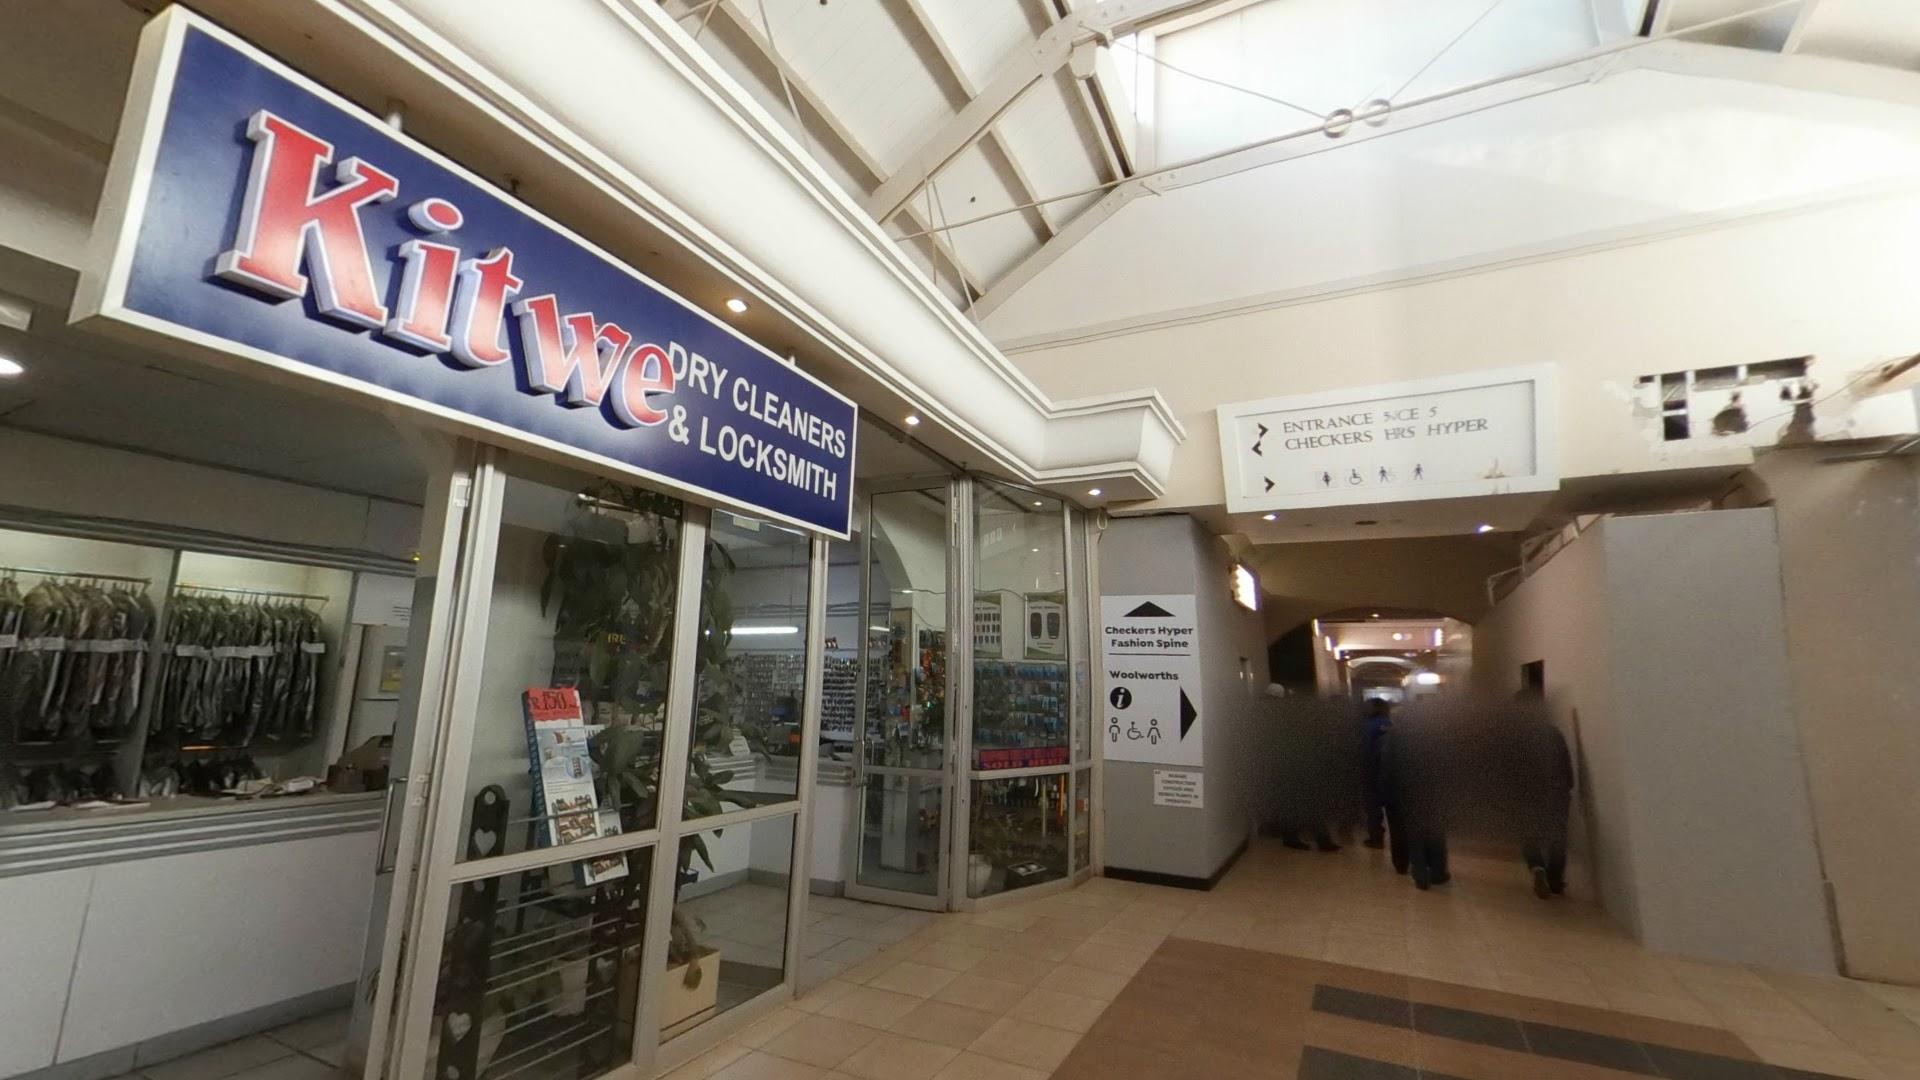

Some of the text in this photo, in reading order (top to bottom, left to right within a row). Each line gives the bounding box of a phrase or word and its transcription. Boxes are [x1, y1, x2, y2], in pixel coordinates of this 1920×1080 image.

[215, 109, 675, 427] Kitwe
[669, 341, 846, 458] DRY CLEANERS
[1283, 412, 1373, 433] ENTRANCE
[1285, 431, 1373, 450] CHECKERS
[1427, 418, 1488, 436] HYPER
[668, 405, 837, 501] & LOCKSMITH
[1105, 626, 1194, 637] Checkers Hyper
[1111, 639, 1189, 649] Fashion Spine
[1109, 670, 1179, 680] Woolworths
